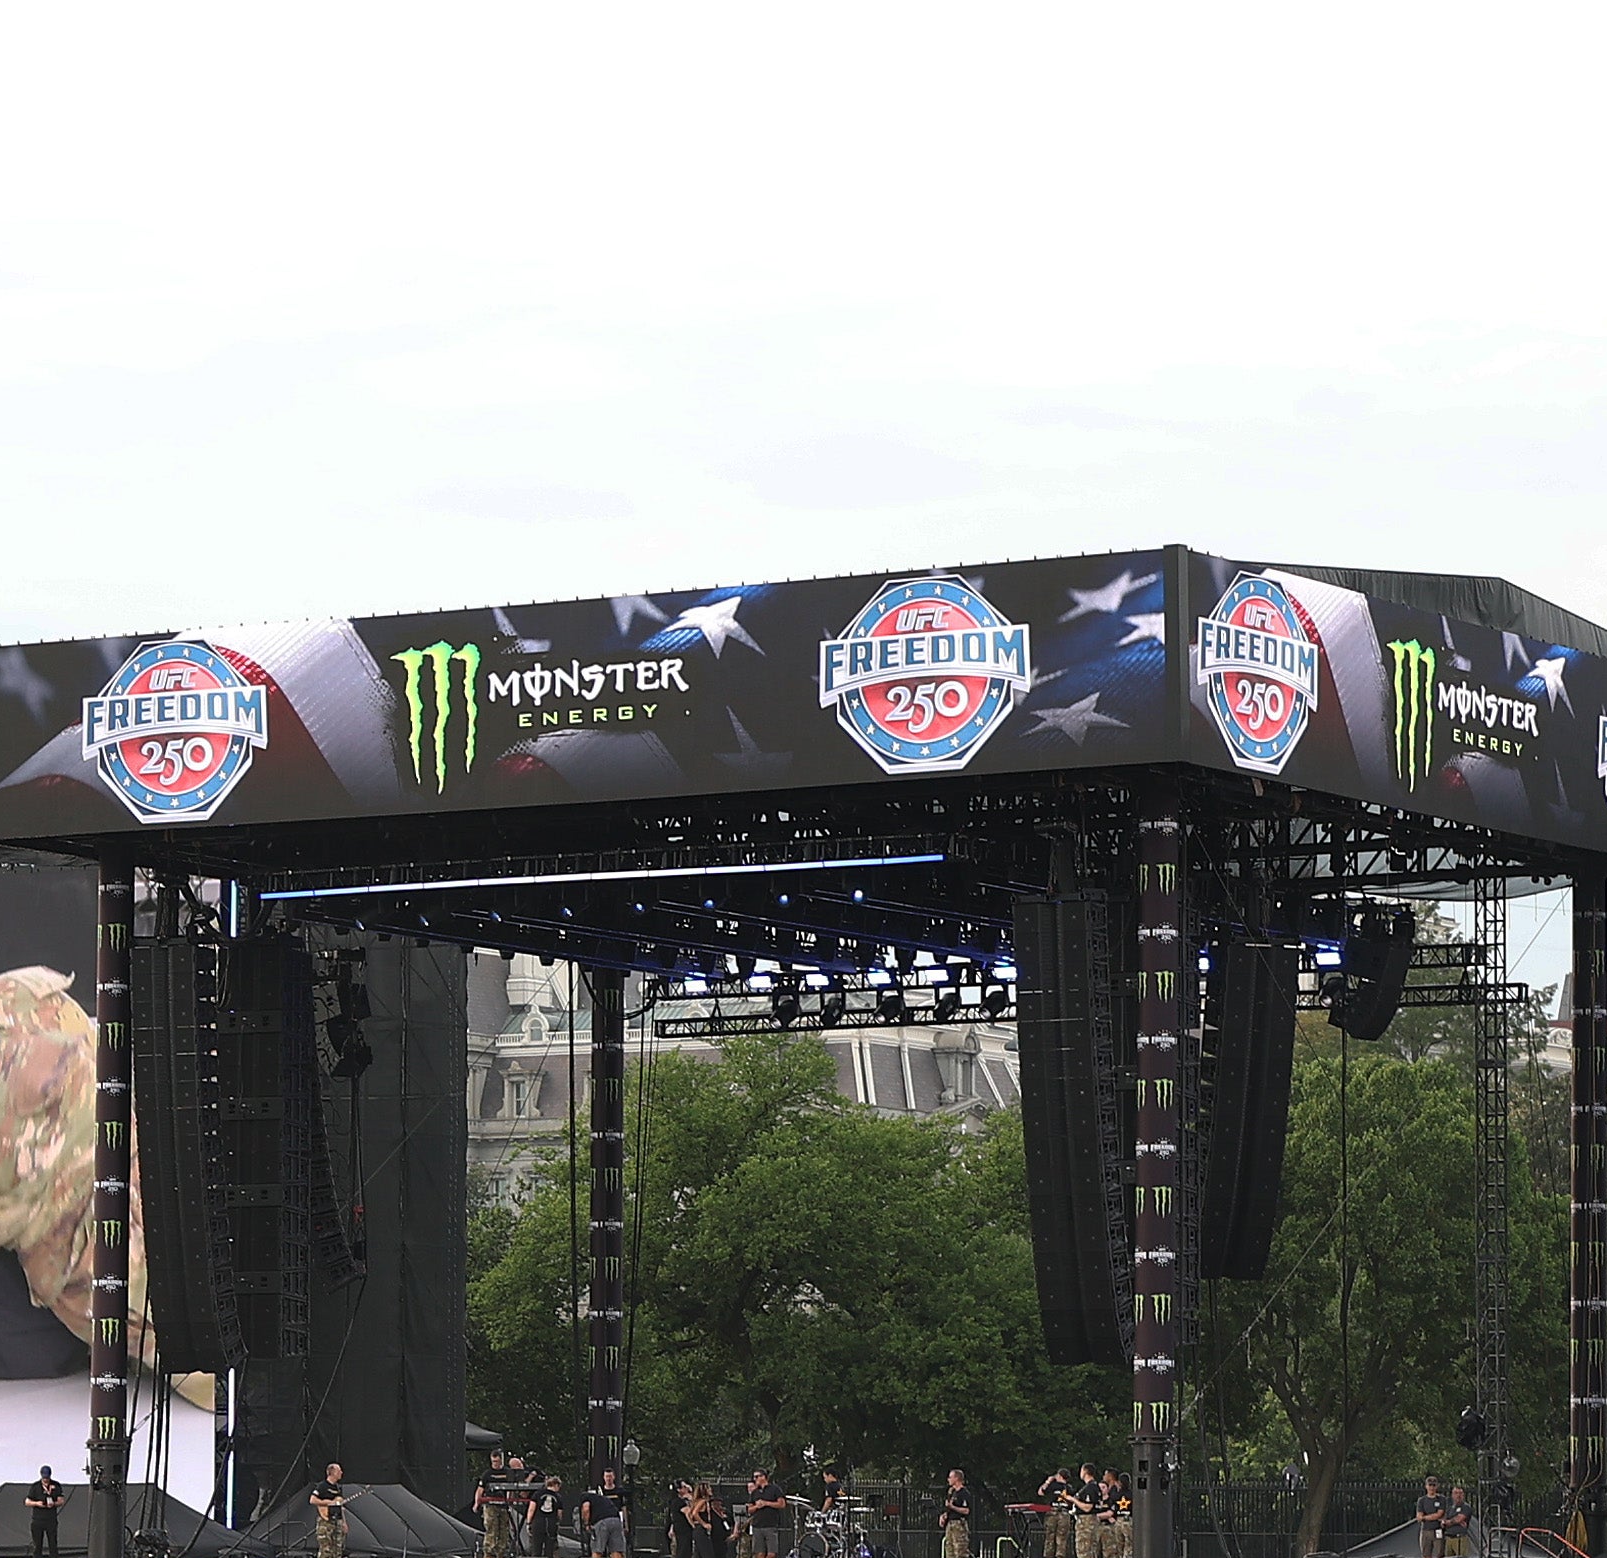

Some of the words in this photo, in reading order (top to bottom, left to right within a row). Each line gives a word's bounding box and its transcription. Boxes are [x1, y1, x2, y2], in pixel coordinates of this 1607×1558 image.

[896, 606, 953, 632] UFC
[1243, 602, 1276, 631] UFC
[149, 667, 198, 691] UFC
[488, 658, 690, 707] MONSTER
[825, 629, 1025, 693] FREEDOM
[1201, 623, 1315, 701] FREEDOM
[86, 690, 263, 746] FREEDOM
[518, 704, 658, 728] ENERGY
[885, 680, 969, 734] 250
[1236, 679, 1284, 731] 250
[1438, 681, 1540, 738] MONSTER
[139, 736, 214, 786] 250
[1452, 728, 1524, 757] ENERGY
